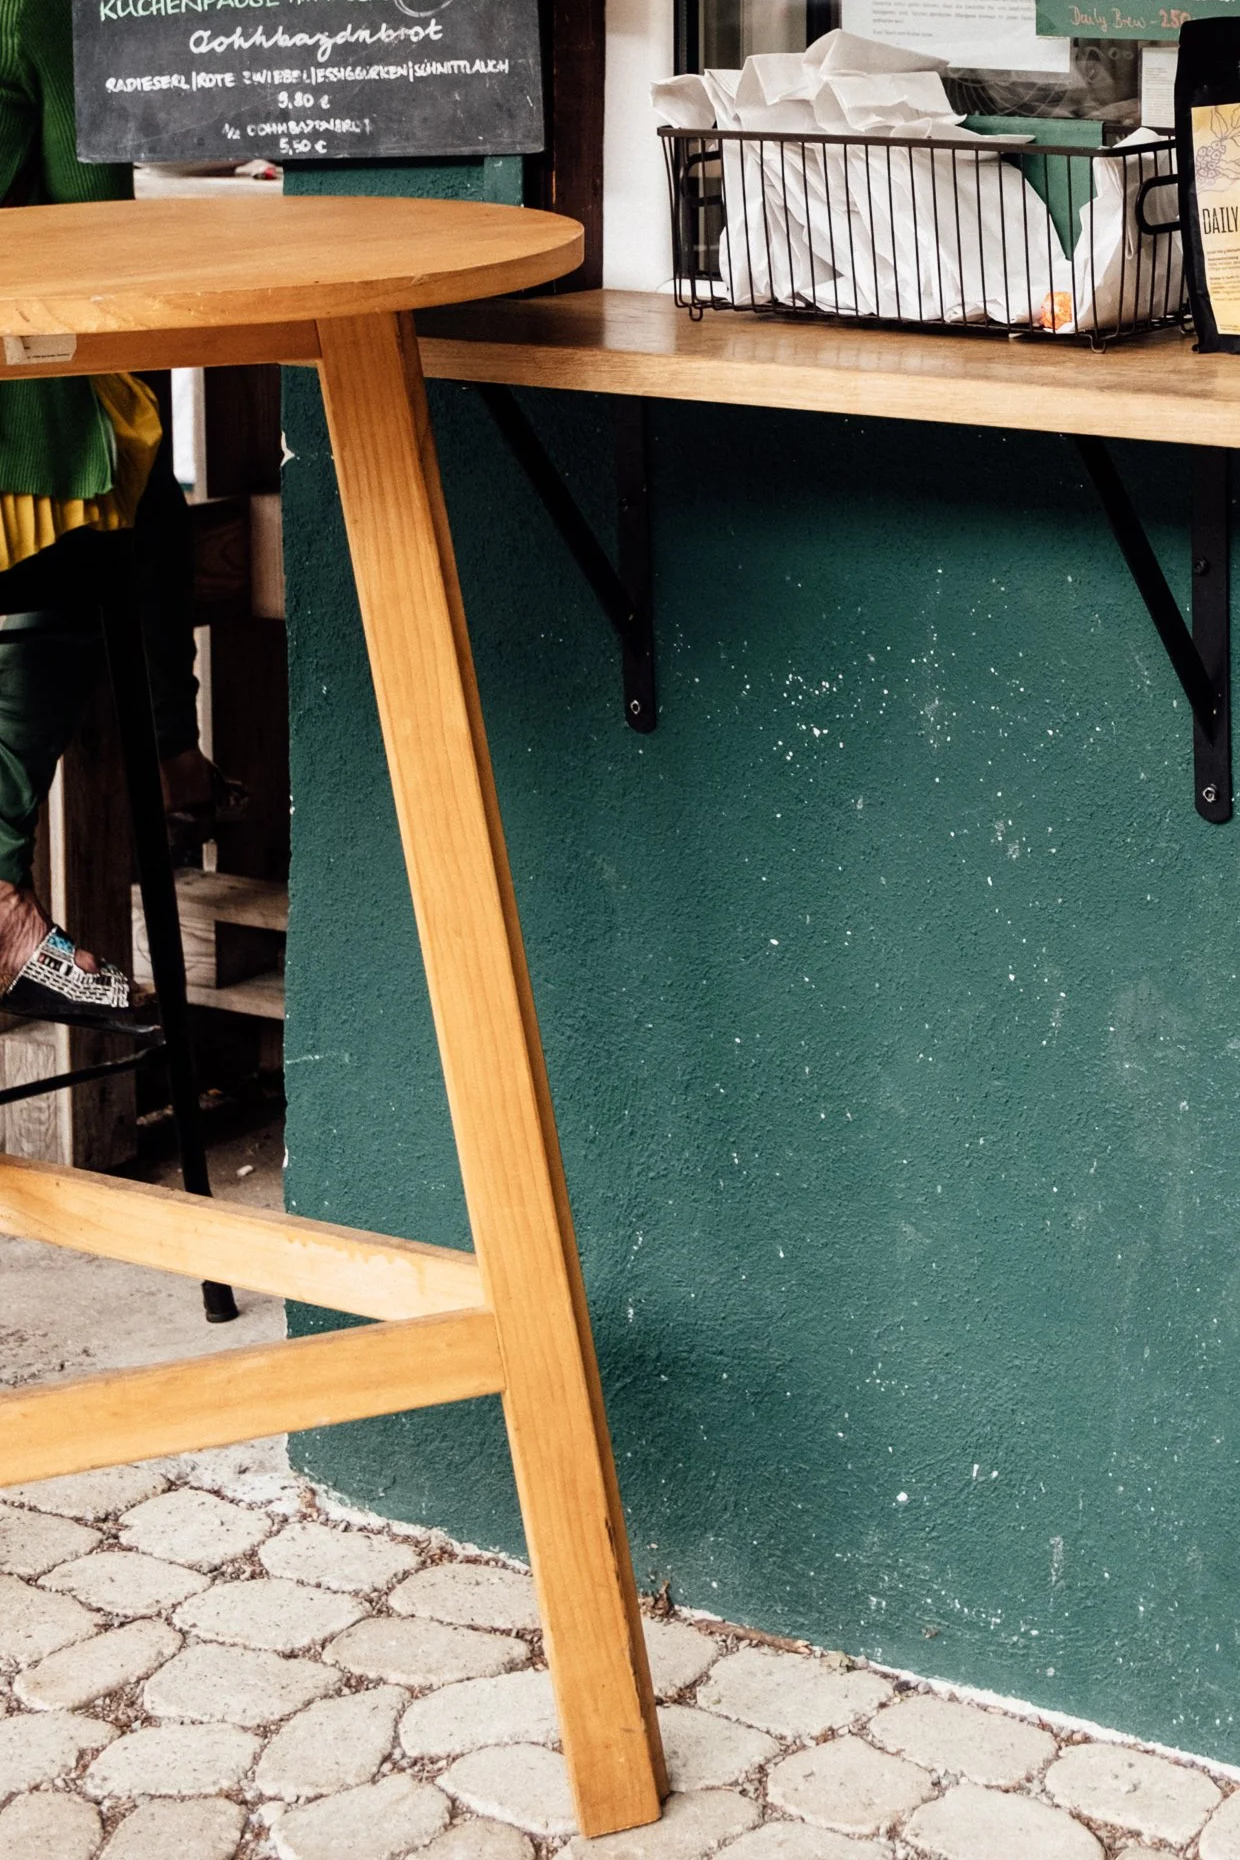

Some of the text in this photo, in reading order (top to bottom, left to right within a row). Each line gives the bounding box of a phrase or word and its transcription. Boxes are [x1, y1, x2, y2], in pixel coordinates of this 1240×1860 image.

[1069, 4, 1147, 32] Daily Brew
[197, 71, 237, 89] ROTE
[1202, 206, 1239, 235] DAILY
